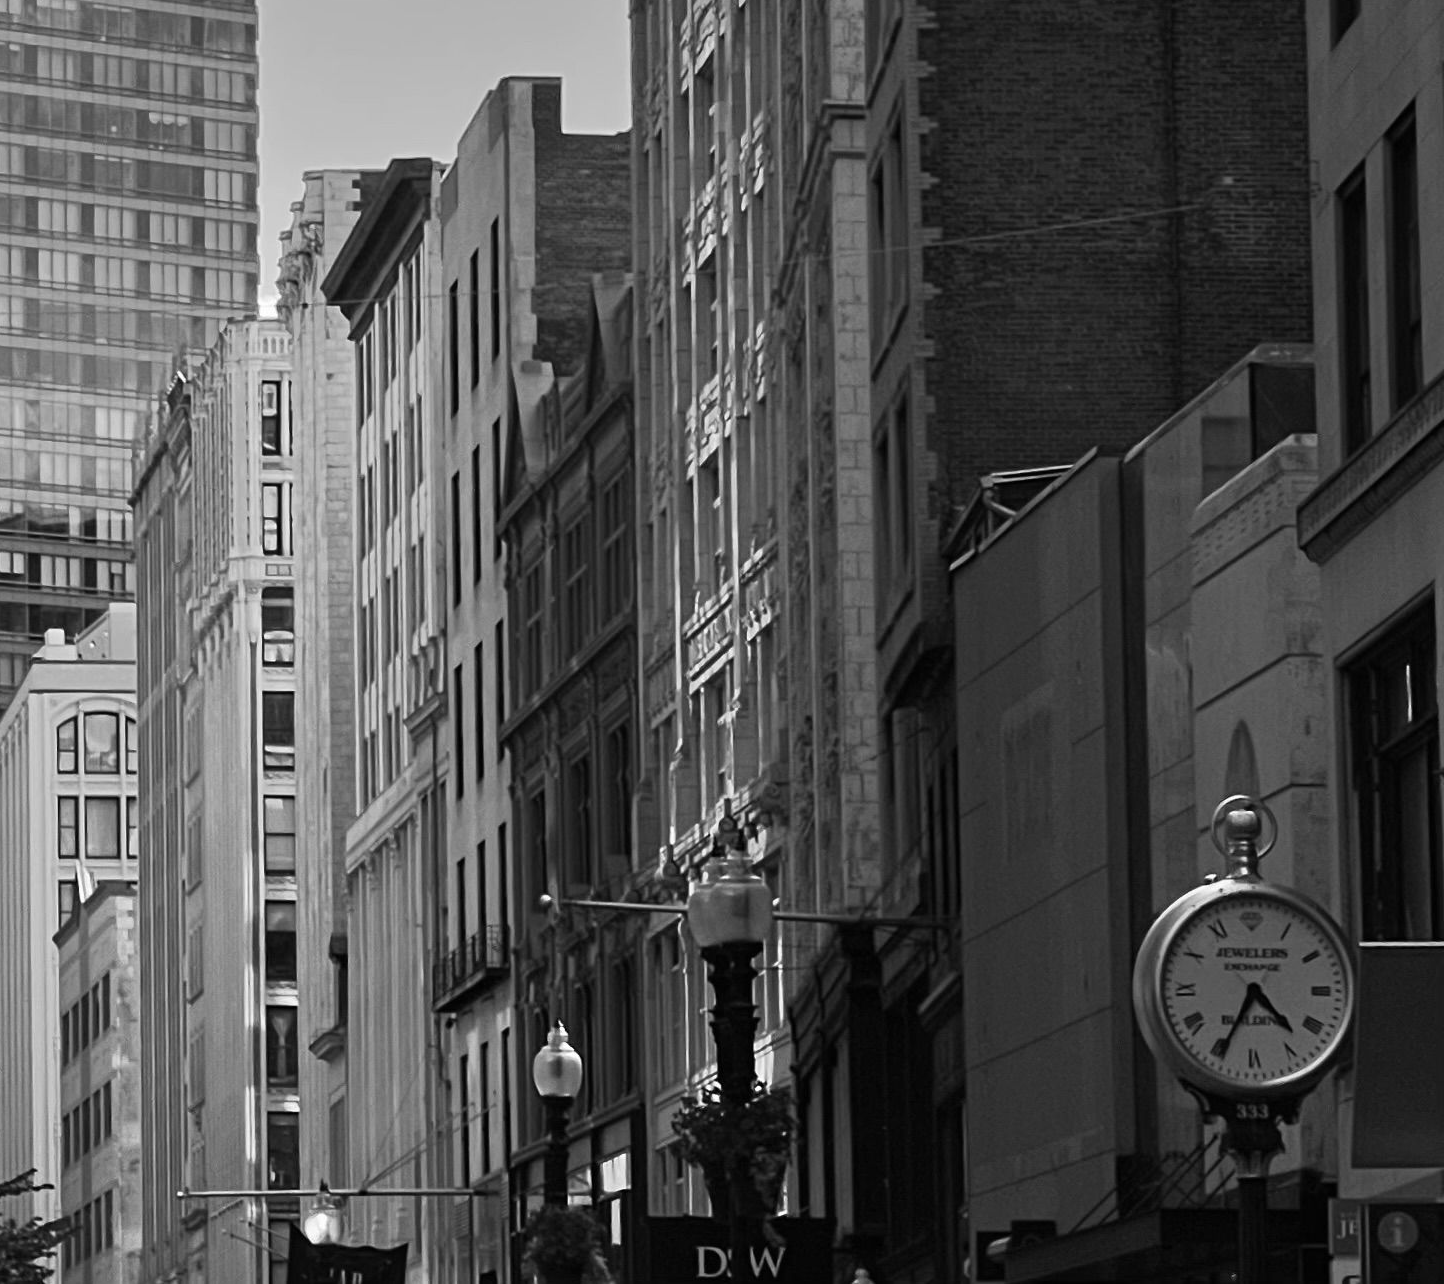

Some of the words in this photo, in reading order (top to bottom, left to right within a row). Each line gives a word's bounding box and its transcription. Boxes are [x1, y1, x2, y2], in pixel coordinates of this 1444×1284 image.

[1215, 946, 1289, 959] JEWELERS
[1223, 962, 1281, 972] EXCHANGE
[1236, 1103, 1270, 1120] 333
